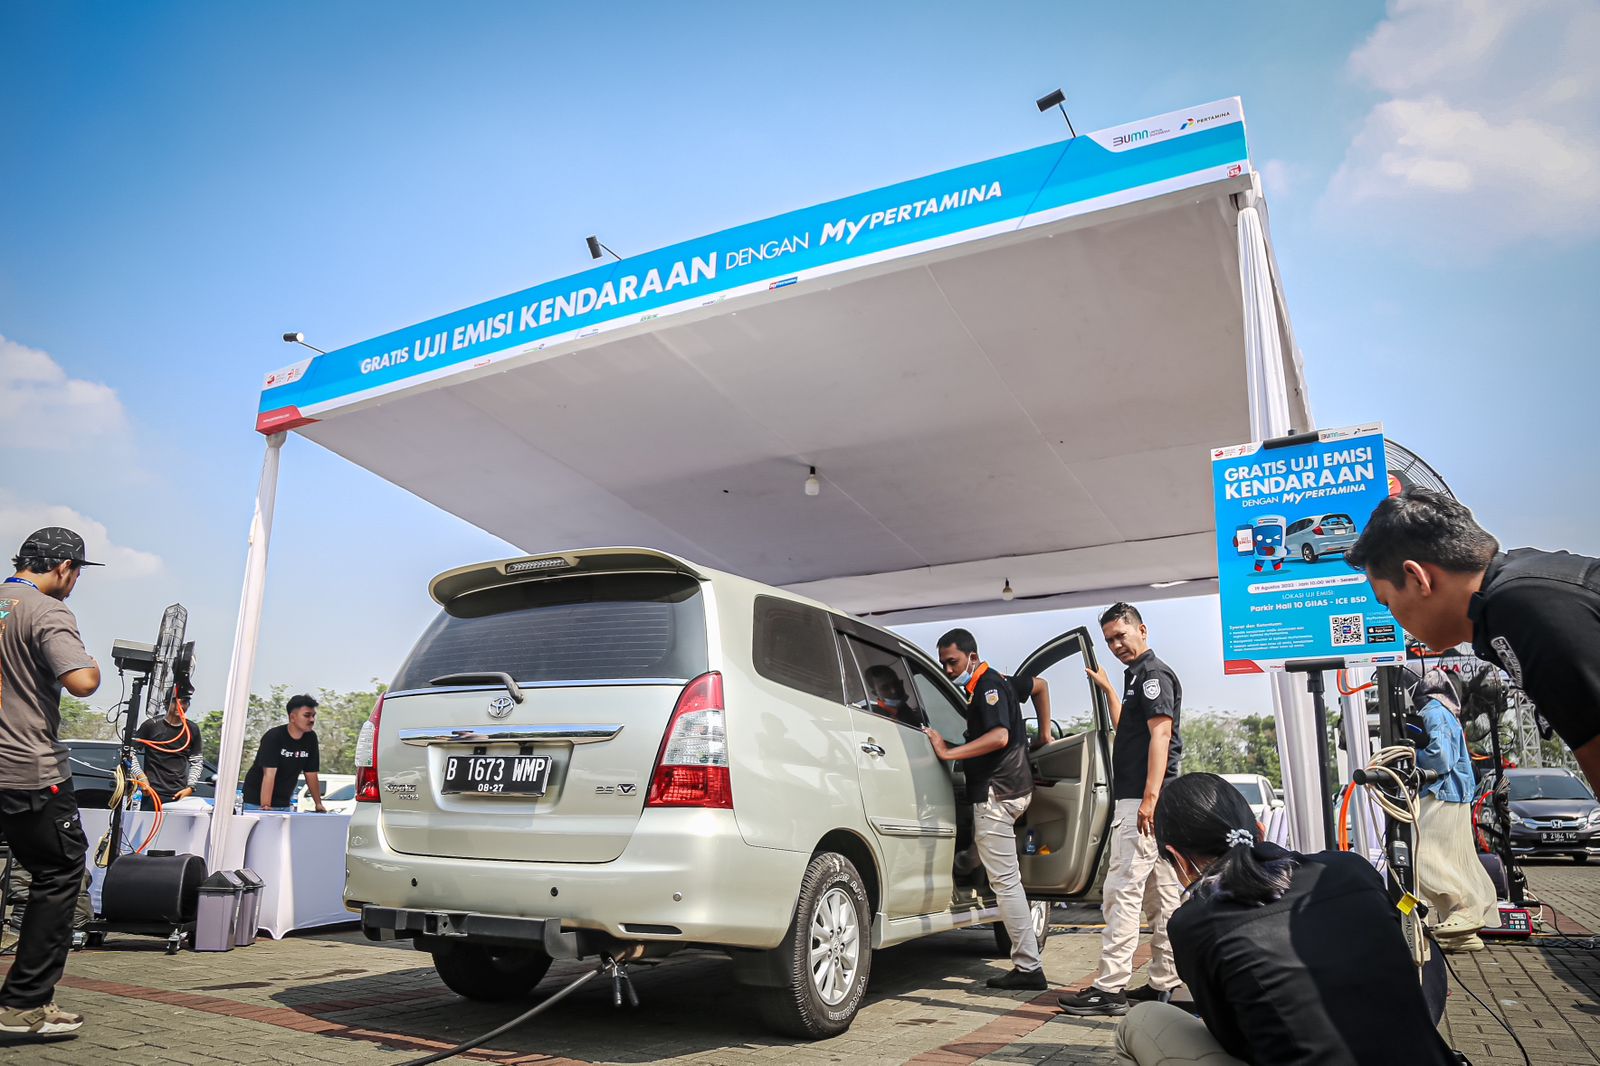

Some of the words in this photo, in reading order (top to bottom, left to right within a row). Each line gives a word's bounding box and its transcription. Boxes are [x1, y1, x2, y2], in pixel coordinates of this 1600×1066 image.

[1197, 112, 1231, 124] PERTAMINA
[360, 346, 409, 375] GRATIS
[413, 332, 448, 362] UJI
[452, 310, 514, 351] EMISI
[519, 251, 718, 332] KENDARAAN
[725, 232, 810, 270] DENGAN
[1224, 460, 1287, 482] GRATIS
[1291, 454, 1319, 471] UJI
[1323, 446, 1373, 467] EMISI
[1225, 462, 1375, 500] KENDARAAN
[1242, 496, 1279, 508] DENGAN
[1250, 603, 1274, 613] Parkir
[1275, 601, 1292, 611] Hall
[1293, 600, 1303, 609] 10
[1305, 599, 1329, 608] GIIAS
[1335, 597, 1349, 605] ICE
[1350, 595, 1367, 604] BSD
[1281, 592, 1304, 600] LOKASI
[446, 758, 458, 780] B
[467, 758, 505, 781] 1673
[512, 758, 546, 782] WMP
